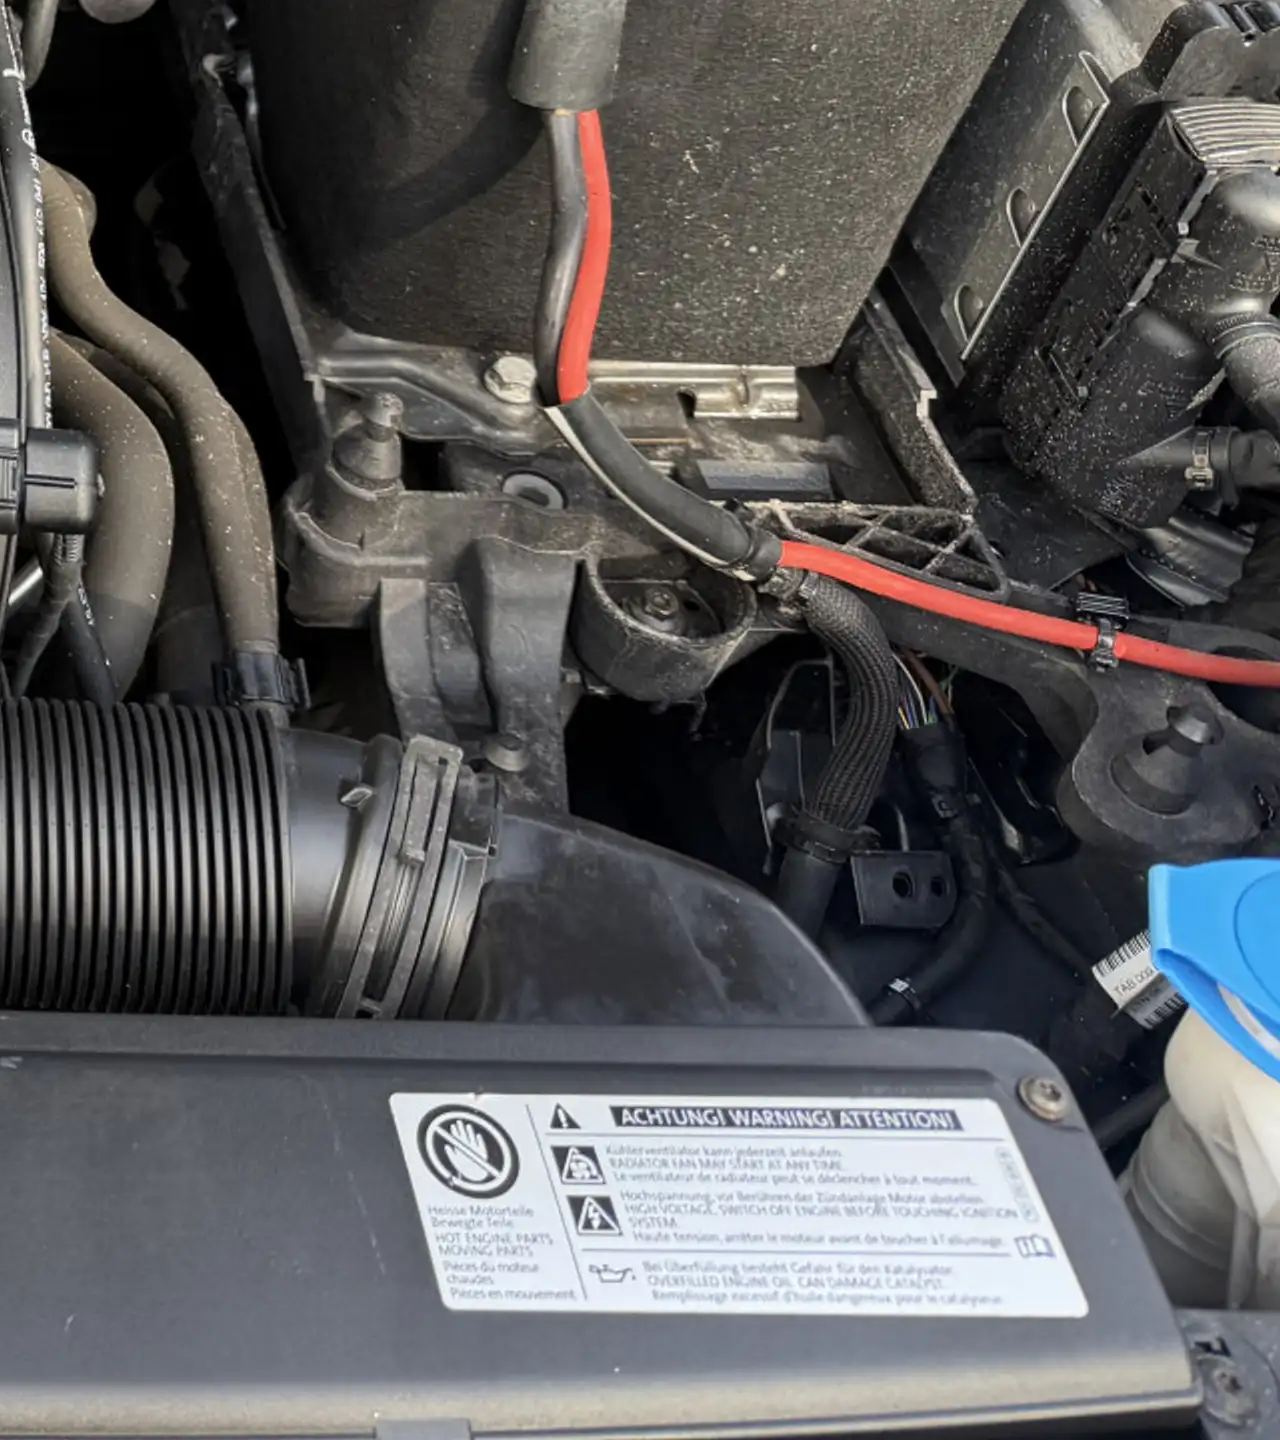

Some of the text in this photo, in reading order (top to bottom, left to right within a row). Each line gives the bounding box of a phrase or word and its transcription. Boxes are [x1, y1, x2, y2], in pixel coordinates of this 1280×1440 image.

[620, 1108, 955, 1128] ACHTUNG! WARNING! ATTENTION!
[436, 1232, 460, 1244] HOT
[464, 1232, 511, 1245] ENGINE
[438, 1244, 493, 1257] MOVING
